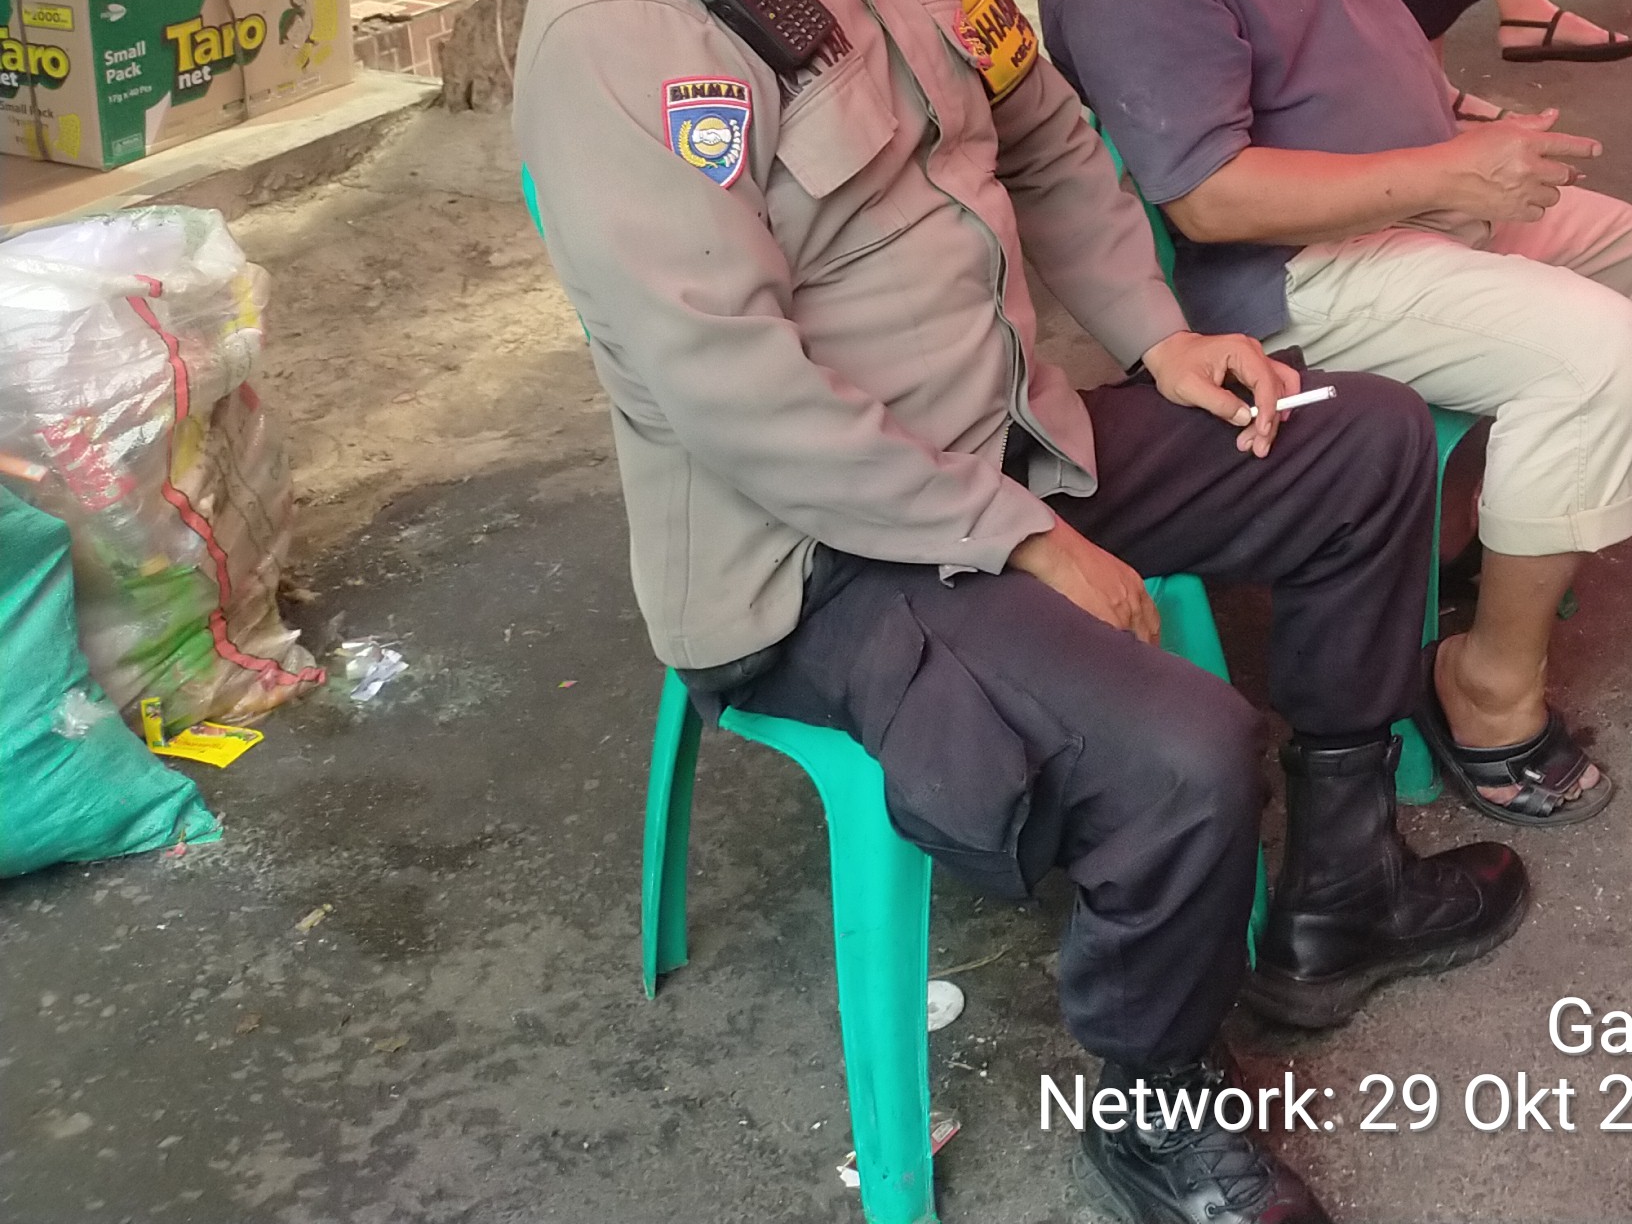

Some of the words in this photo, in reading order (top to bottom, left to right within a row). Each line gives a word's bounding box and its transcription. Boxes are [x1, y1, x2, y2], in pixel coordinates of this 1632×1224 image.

[104, 40, 146, 66] Small
[164, 14, 267, 73] Taro
[0, 72, 18, 87] et
[106, 62, 142, 84] Pack
[178, 65, 212, 90] net
